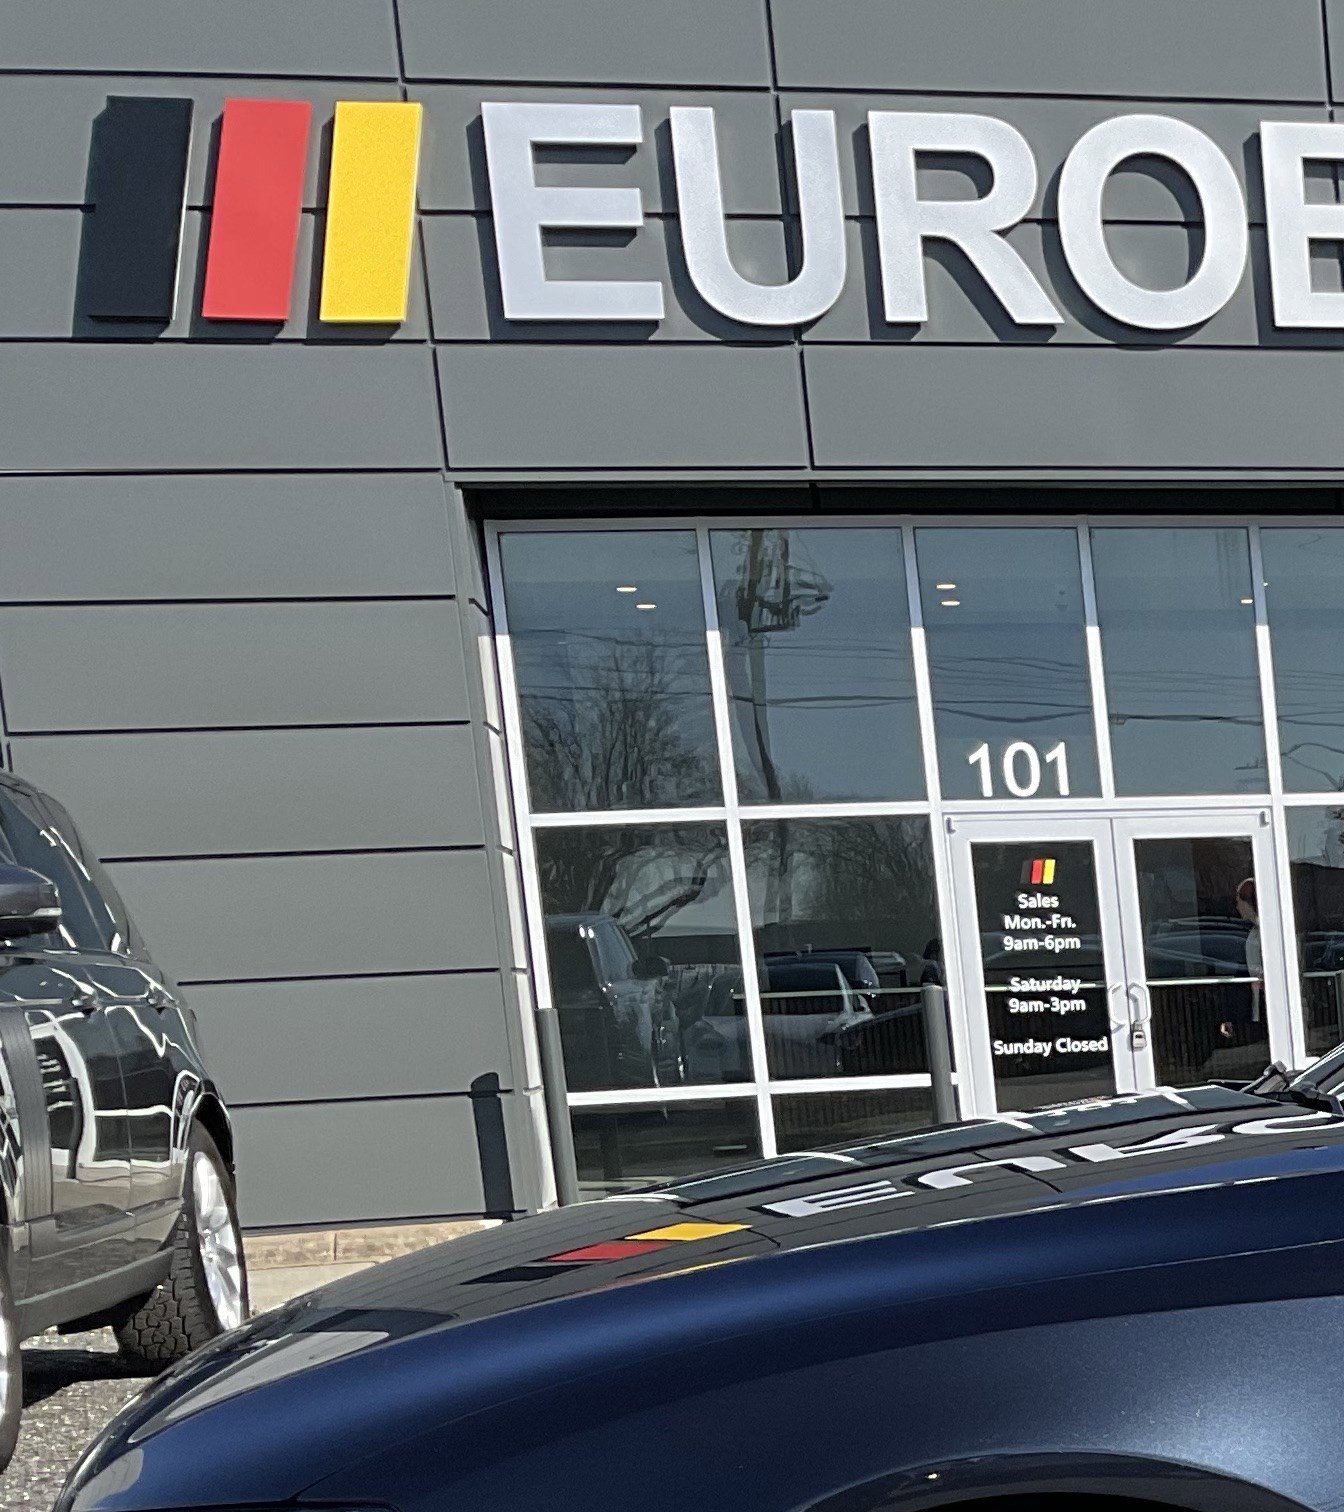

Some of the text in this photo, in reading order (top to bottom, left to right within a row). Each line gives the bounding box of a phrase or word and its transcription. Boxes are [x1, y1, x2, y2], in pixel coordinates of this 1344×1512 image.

[968, 741, 1070, 797] 101
[1017, 893, 1060, 909] Sales
[1004, 914, 1077, 930] Mon.-Fri.
[1003, 935, 1081, 953] 9am-6pm
[1010, 976, 1081, 994] Saturday
[1009, 997, 1086, 1015] 9am-3pm
[994, 1036, 1108, 1057] Sunday Closed
